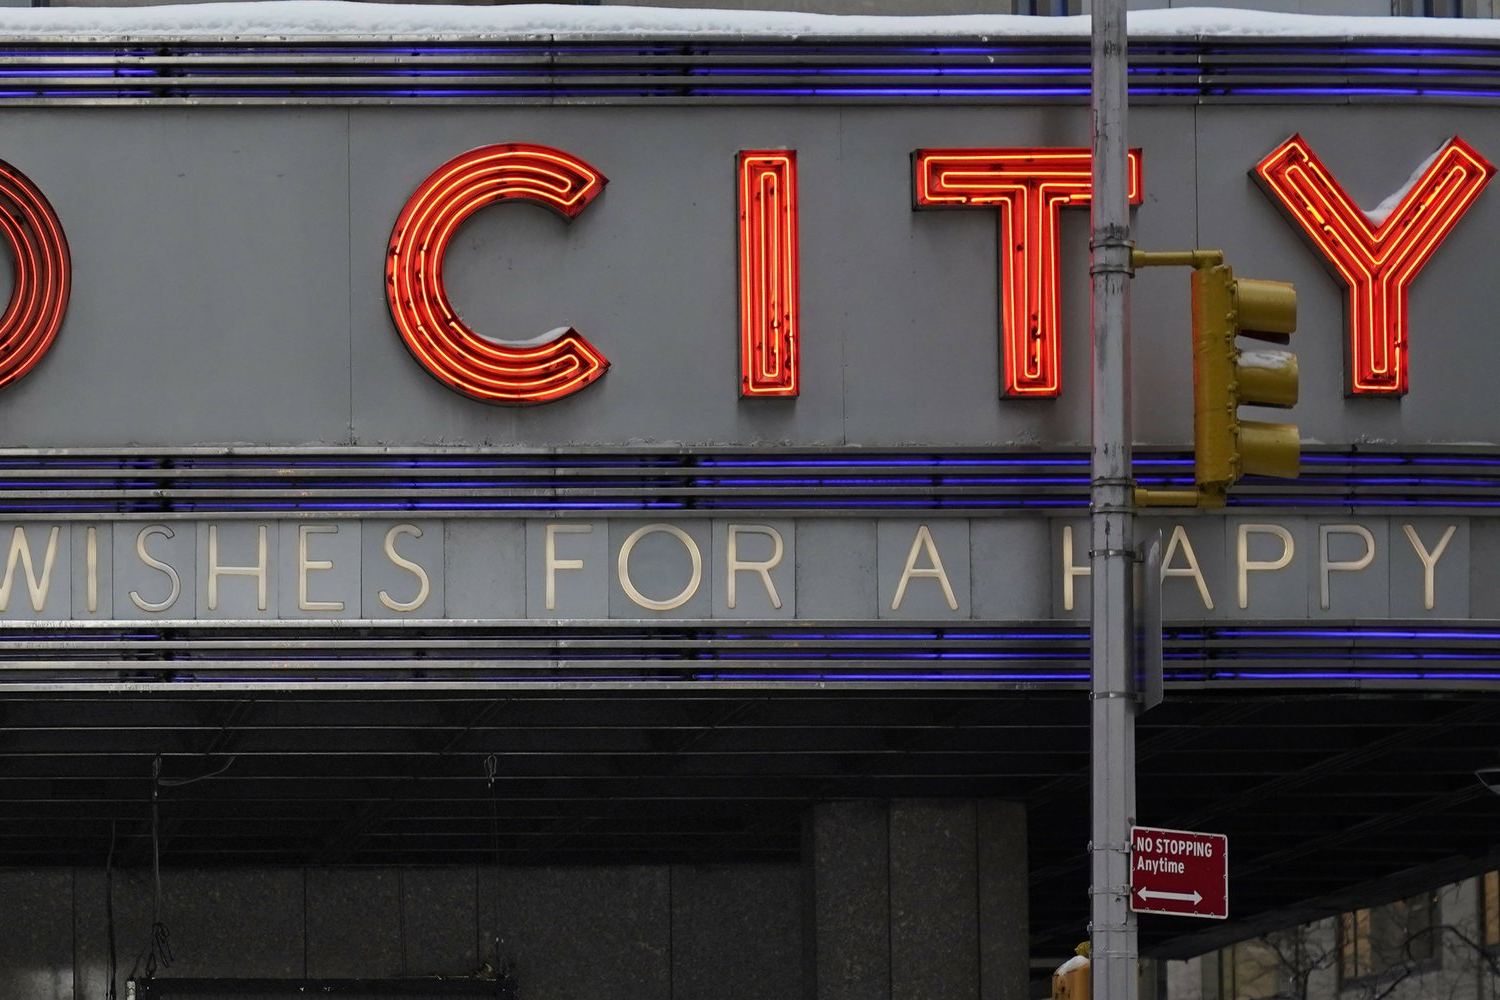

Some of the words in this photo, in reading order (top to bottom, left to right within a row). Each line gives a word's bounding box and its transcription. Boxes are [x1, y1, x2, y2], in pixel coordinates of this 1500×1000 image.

[384, 132, 1497, 406] CITY
[545, 522, 783, 611] FOR
[891, 525, 958, 611] A
[1137, 837, 1153, 852] NO
[1156, 838, 1213, 858] STOPPING
[1137, 855, 1185, 875] Anytime
